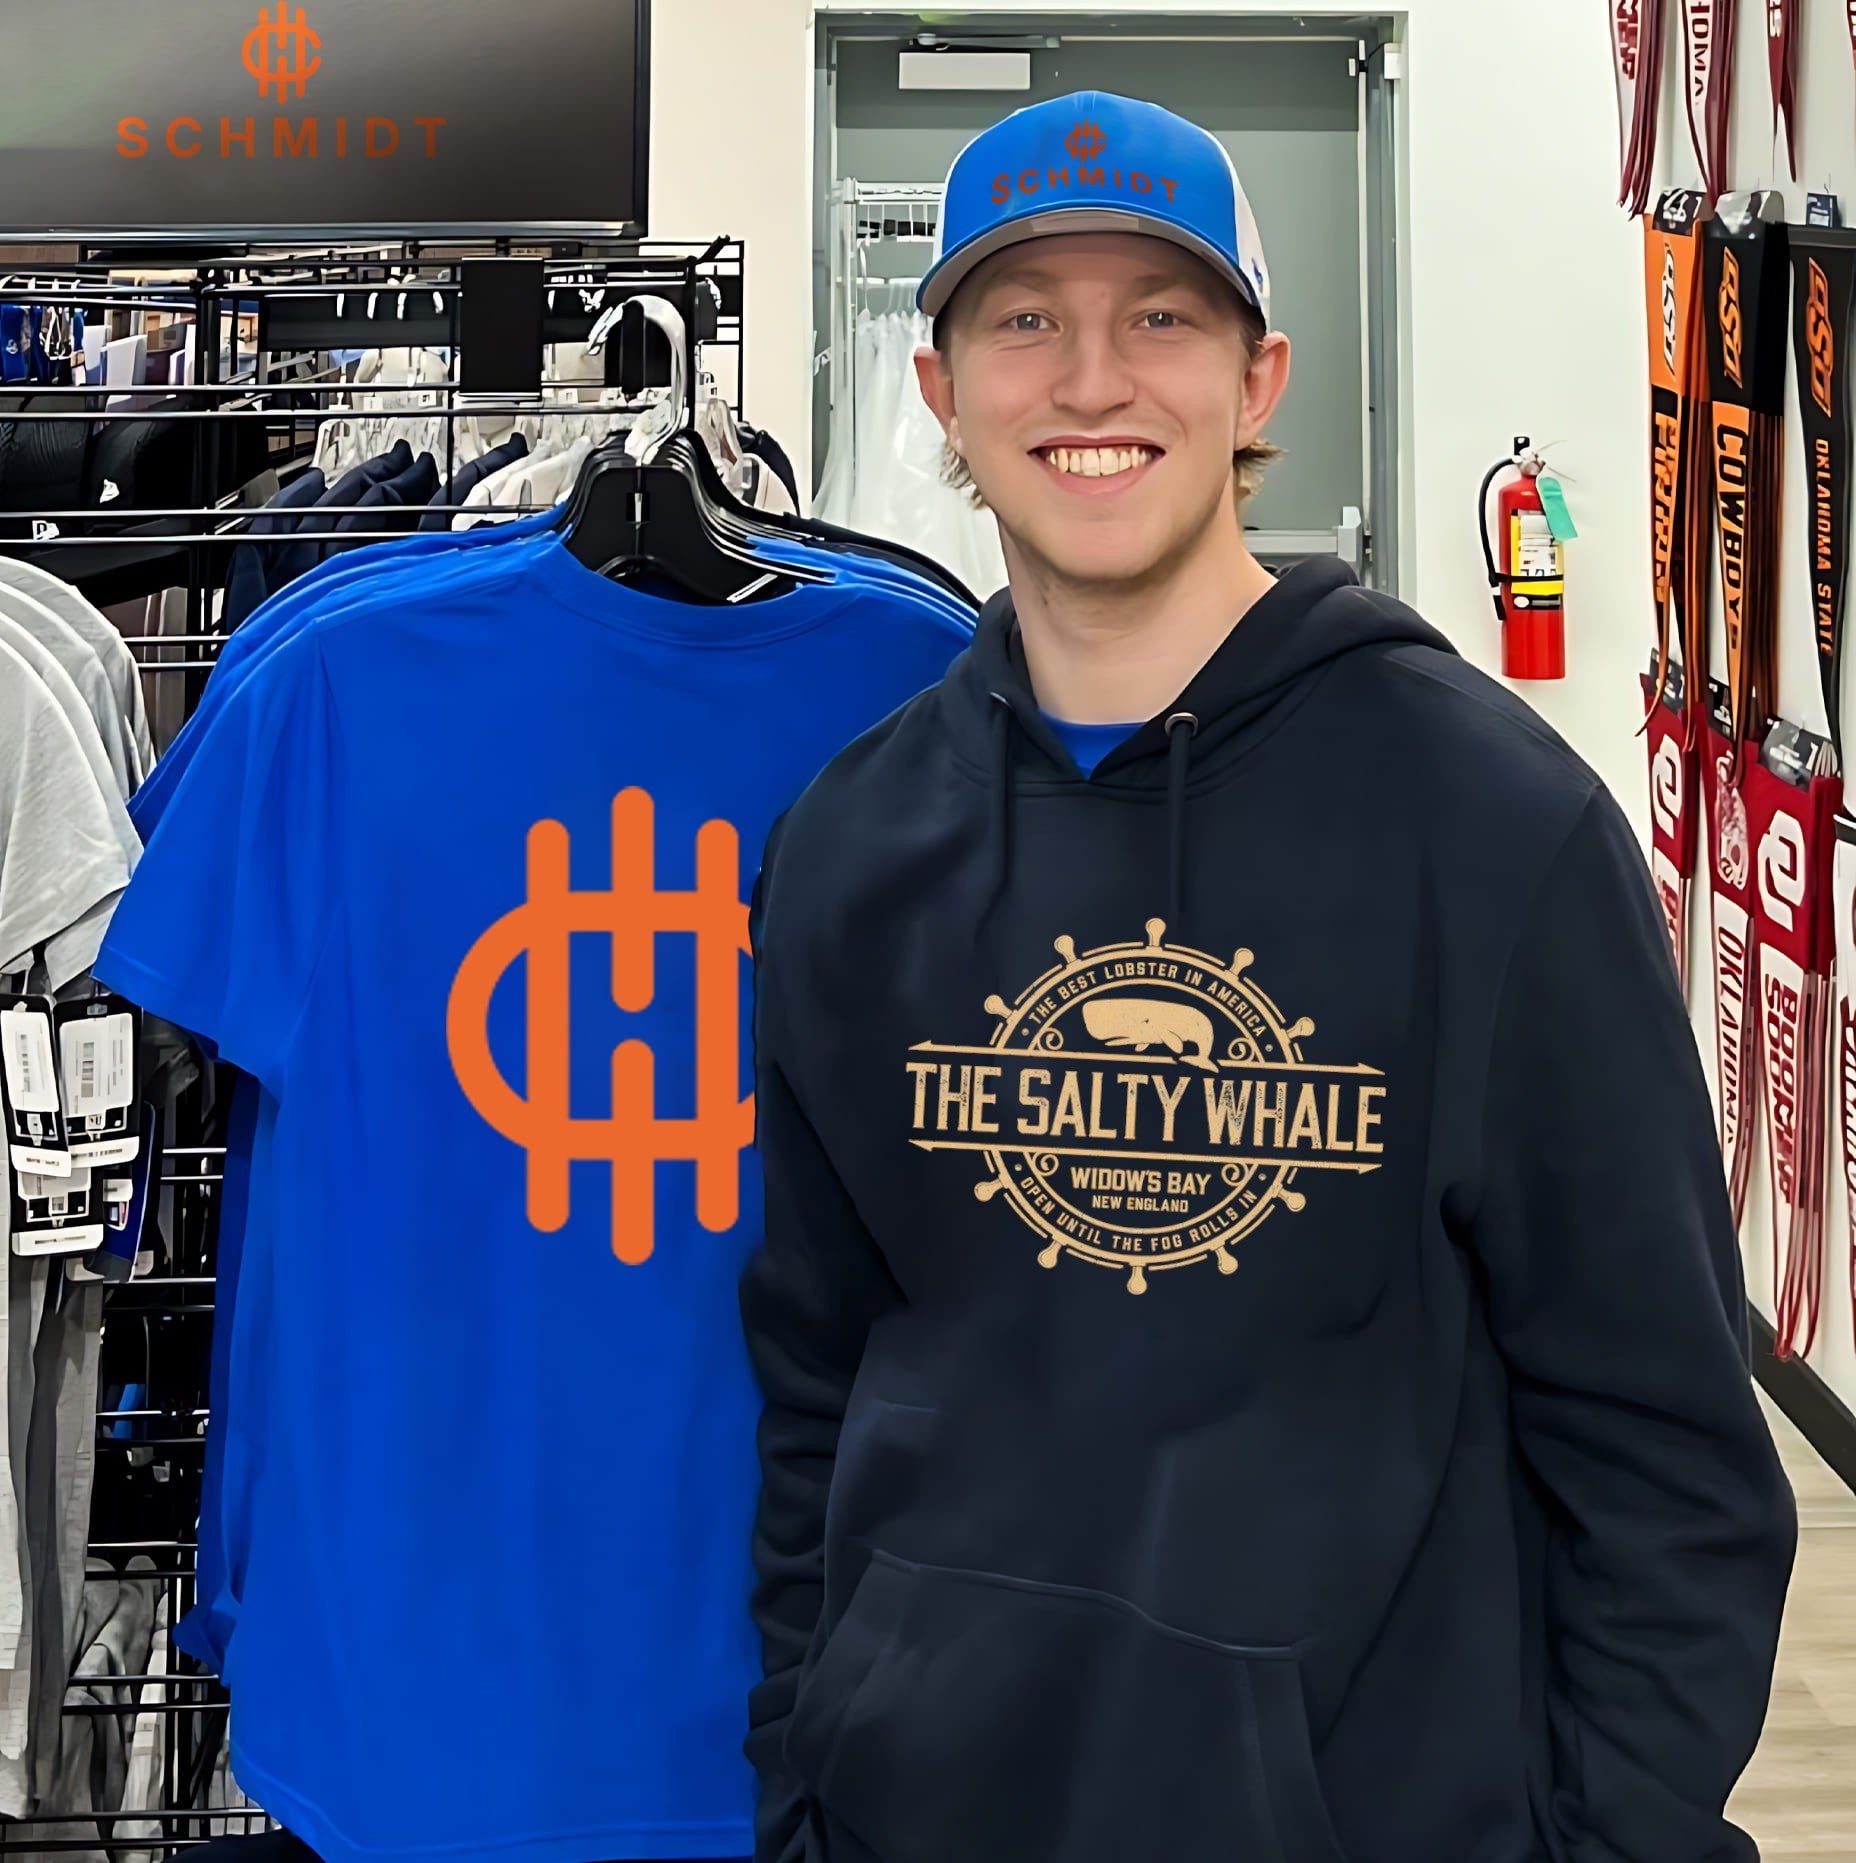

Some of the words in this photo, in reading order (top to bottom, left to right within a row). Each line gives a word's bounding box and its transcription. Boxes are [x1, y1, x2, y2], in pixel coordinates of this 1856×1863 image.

[1690, 0, 1711, 97] HOMA
[115, 116, 448, 159] SCHMIDT
[991, 167, 1180, 204] SCHMIDT
[1815, 438, 1833, 570] OKLAHOMA
[1029, 997, 1057, 1025] THE
[1057, 971, 1099, 998] BEST
[1104, 962, 1179, 980] LOBSTER
[1185, 969, 1203, 986] IN
[1206, 981, 1267, 1038] AMERICA
[905, 1062, 1002, 1133] THE
[1017, 1068, 1191, 1142] SALTY
[1203, 1078, 1387, 1153] WHALE
[1020, 1176, 1055, 1215] OPEN
[1056, 1211, 1101, 1246] UNTIL
[1112, 1235, 1143, 1252] THE
[1150, 1234, 1182, 1252] FOG
[1188, 1209, 1239, 1244] ROLLS
[1238, 1189, 1258, 1209] IN
[1070, 1166, 1162, 1193] WIDOW'S
[1167, 1171, 1212, 1195] BAY
[1092, 1194, 1123, 1210] NEW
[1126, 1196, 1189, 1213] ENGLAND
